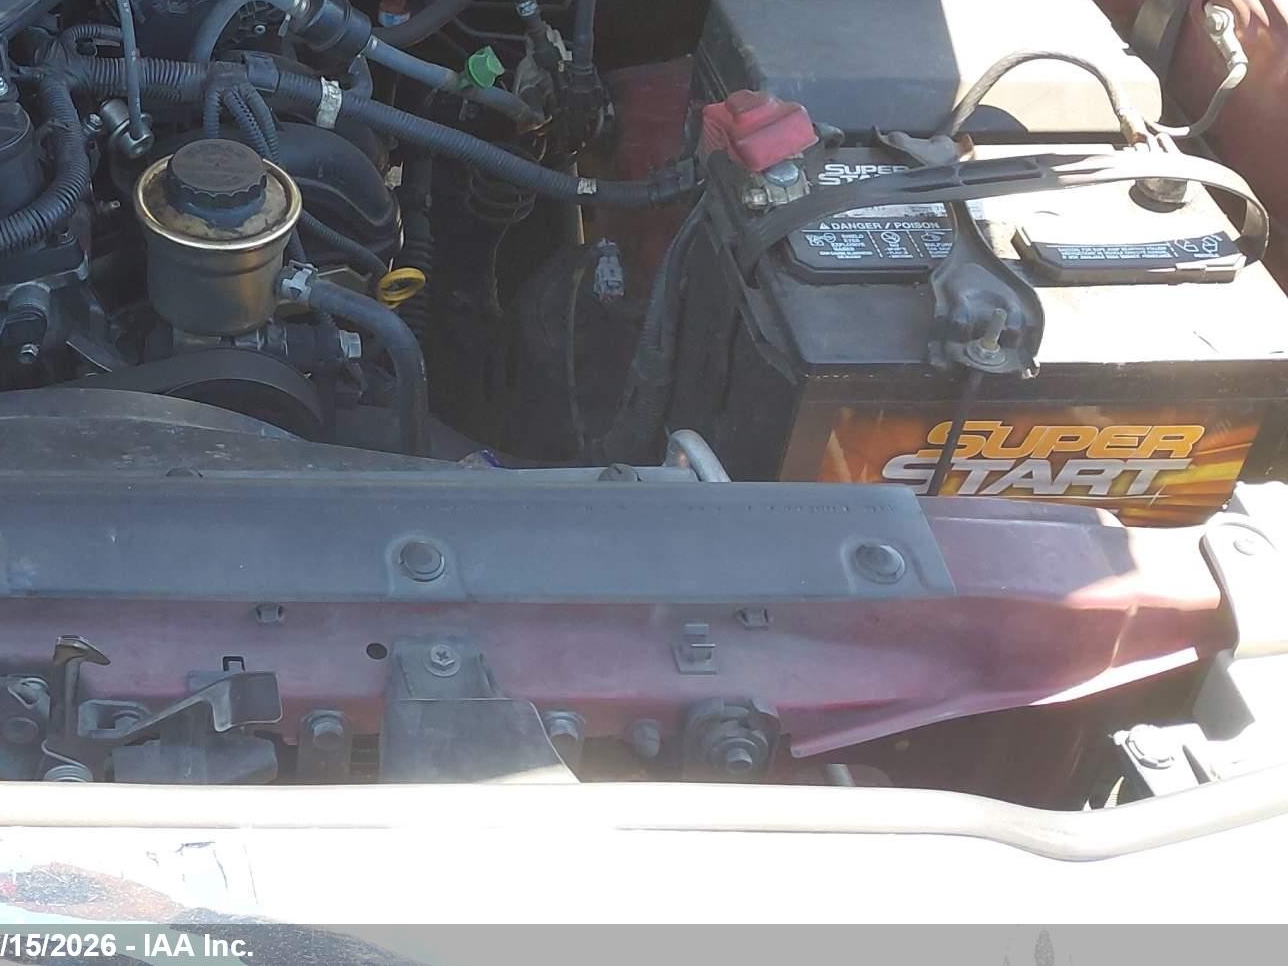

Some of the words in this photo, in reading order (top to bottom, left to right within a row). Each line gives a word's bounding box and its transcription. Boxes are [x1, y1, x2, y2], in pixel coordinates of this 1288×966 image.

[831, 222, 881, 230] DANGER
[914, 420, 1206, 459] SUPER
[881, 454, 1193, 495] START
